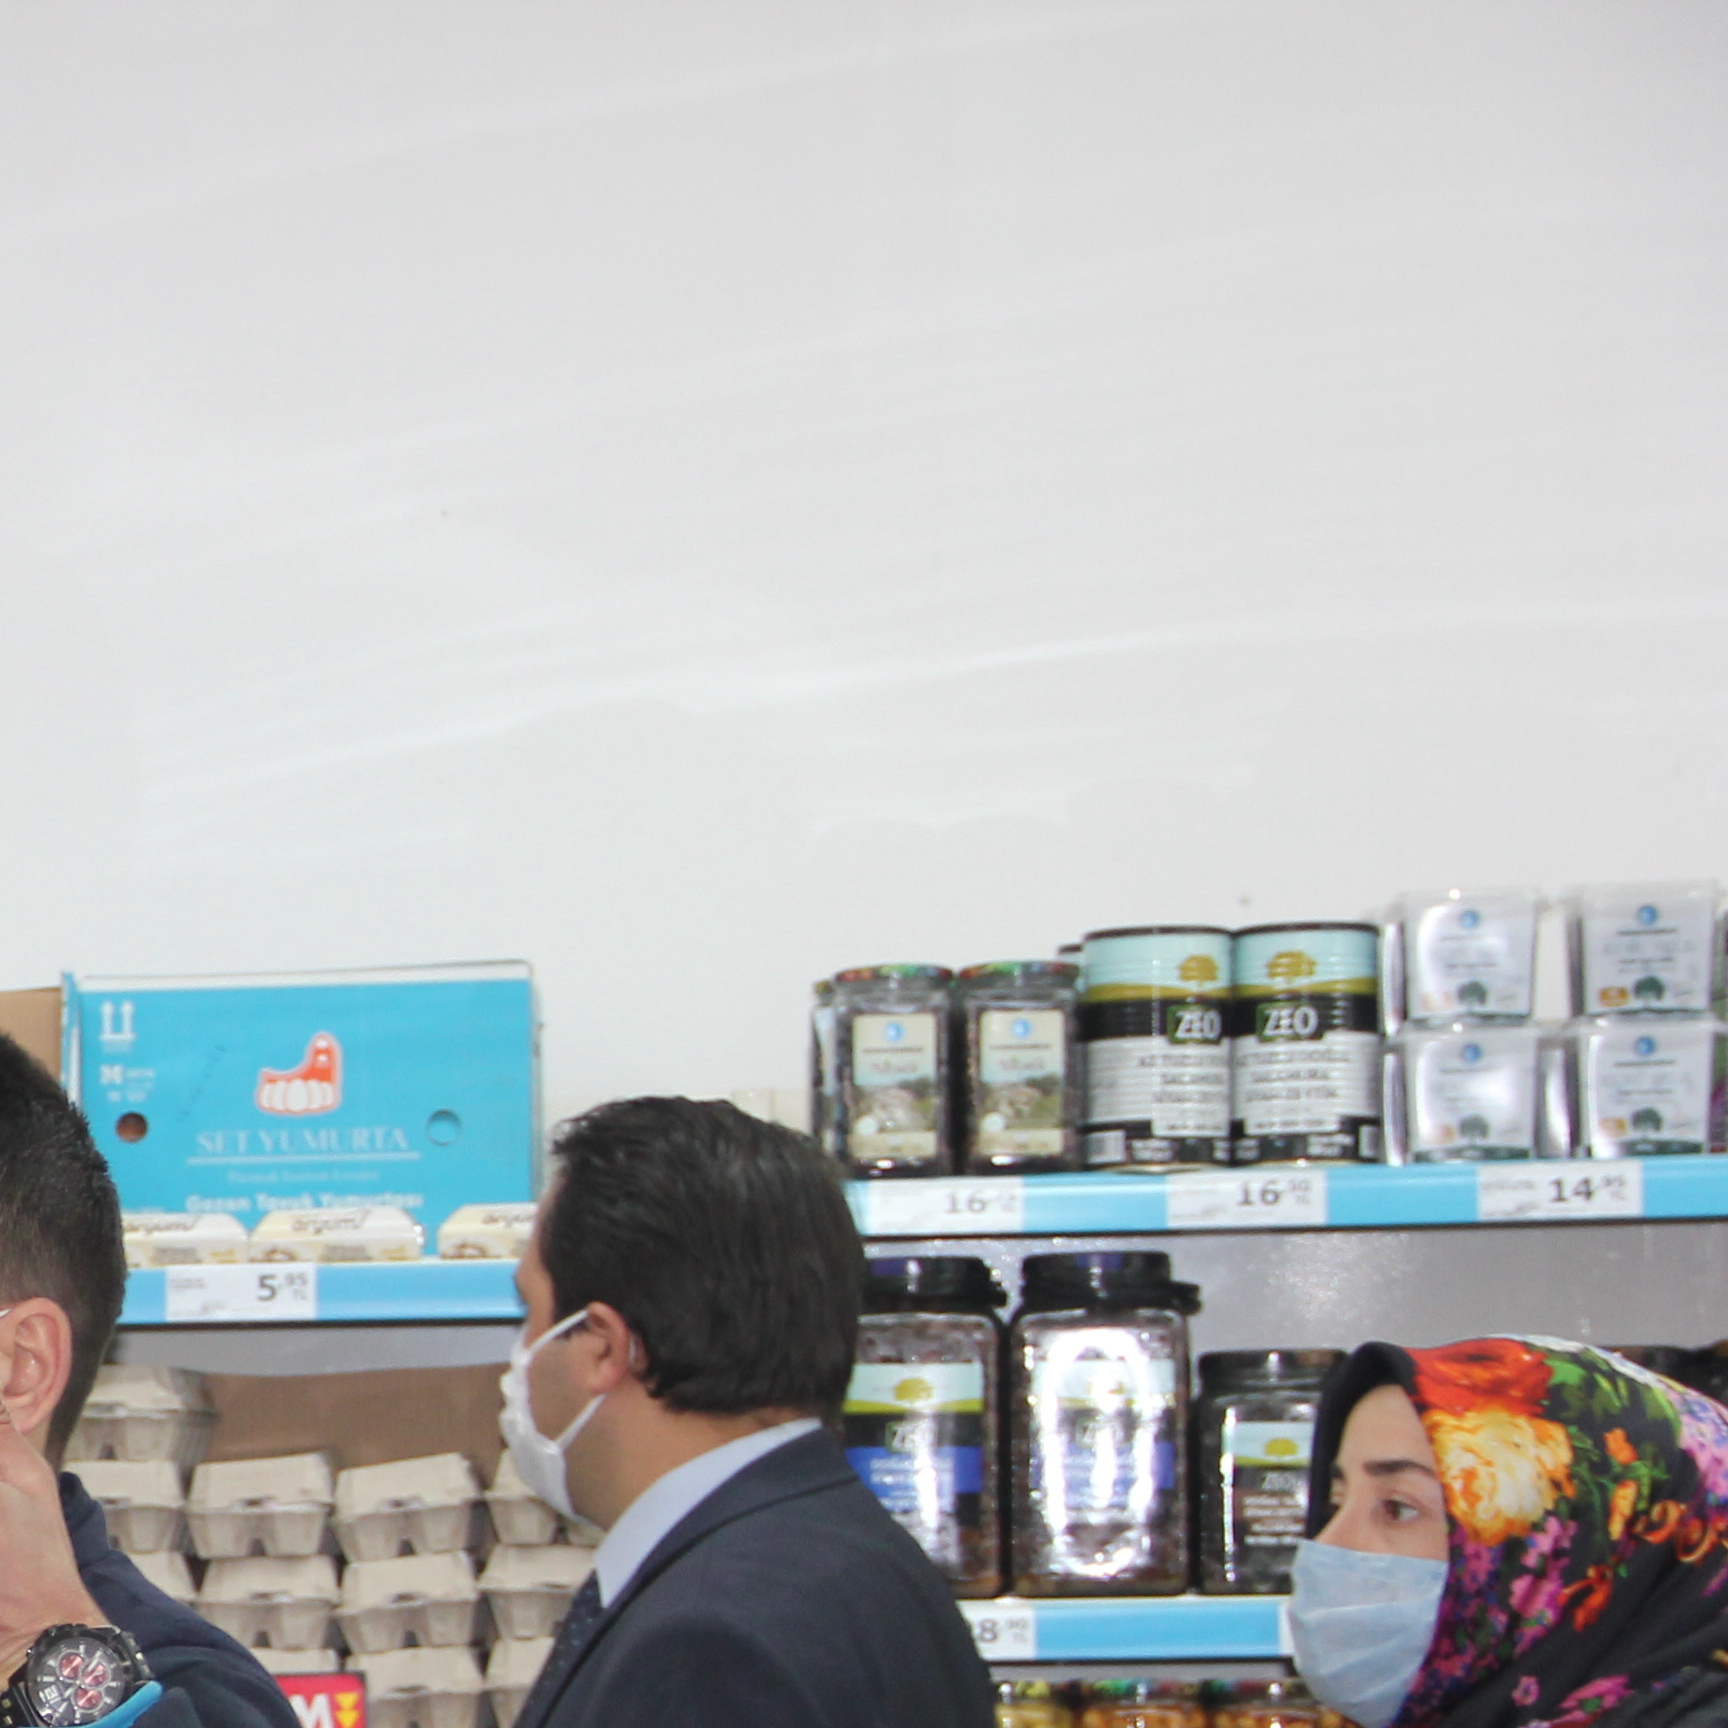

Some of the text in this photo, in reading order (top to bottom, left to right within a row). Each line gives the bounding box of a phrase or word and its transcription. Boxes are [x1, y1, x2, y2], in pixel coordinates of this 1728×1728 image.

[1175, 1010, 1222, 1039] ZEO
[1263, 1006, 1319, 1036] ZEO
[197, 1126, 410, 1152] SET YUMURTA
[1237, 1180, 1280, 1206] 16
[1548, 1177, 1594, 1203] 14
